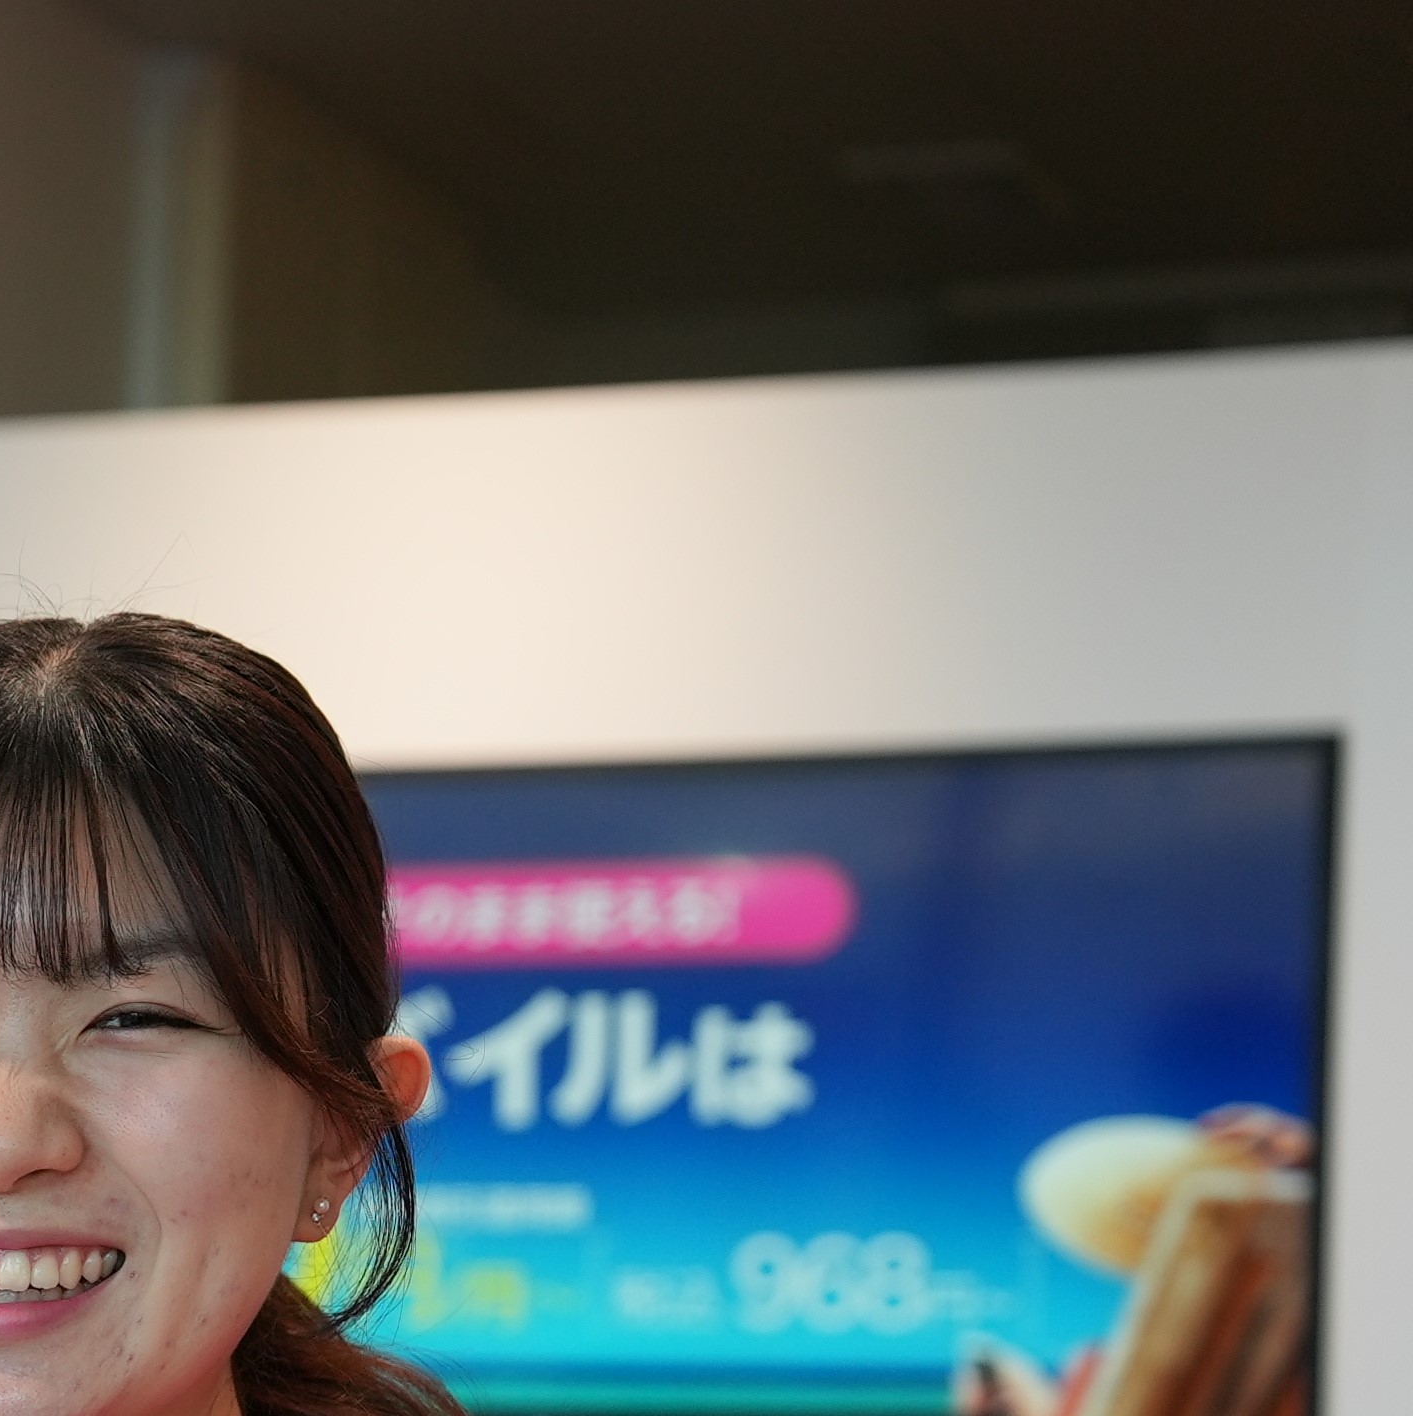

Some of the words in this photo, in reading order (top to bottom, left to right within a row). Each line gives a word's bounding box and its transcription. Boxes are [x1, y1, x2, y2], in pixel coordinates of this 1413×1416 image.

[386, 872, 743, 952] のまま使える!
